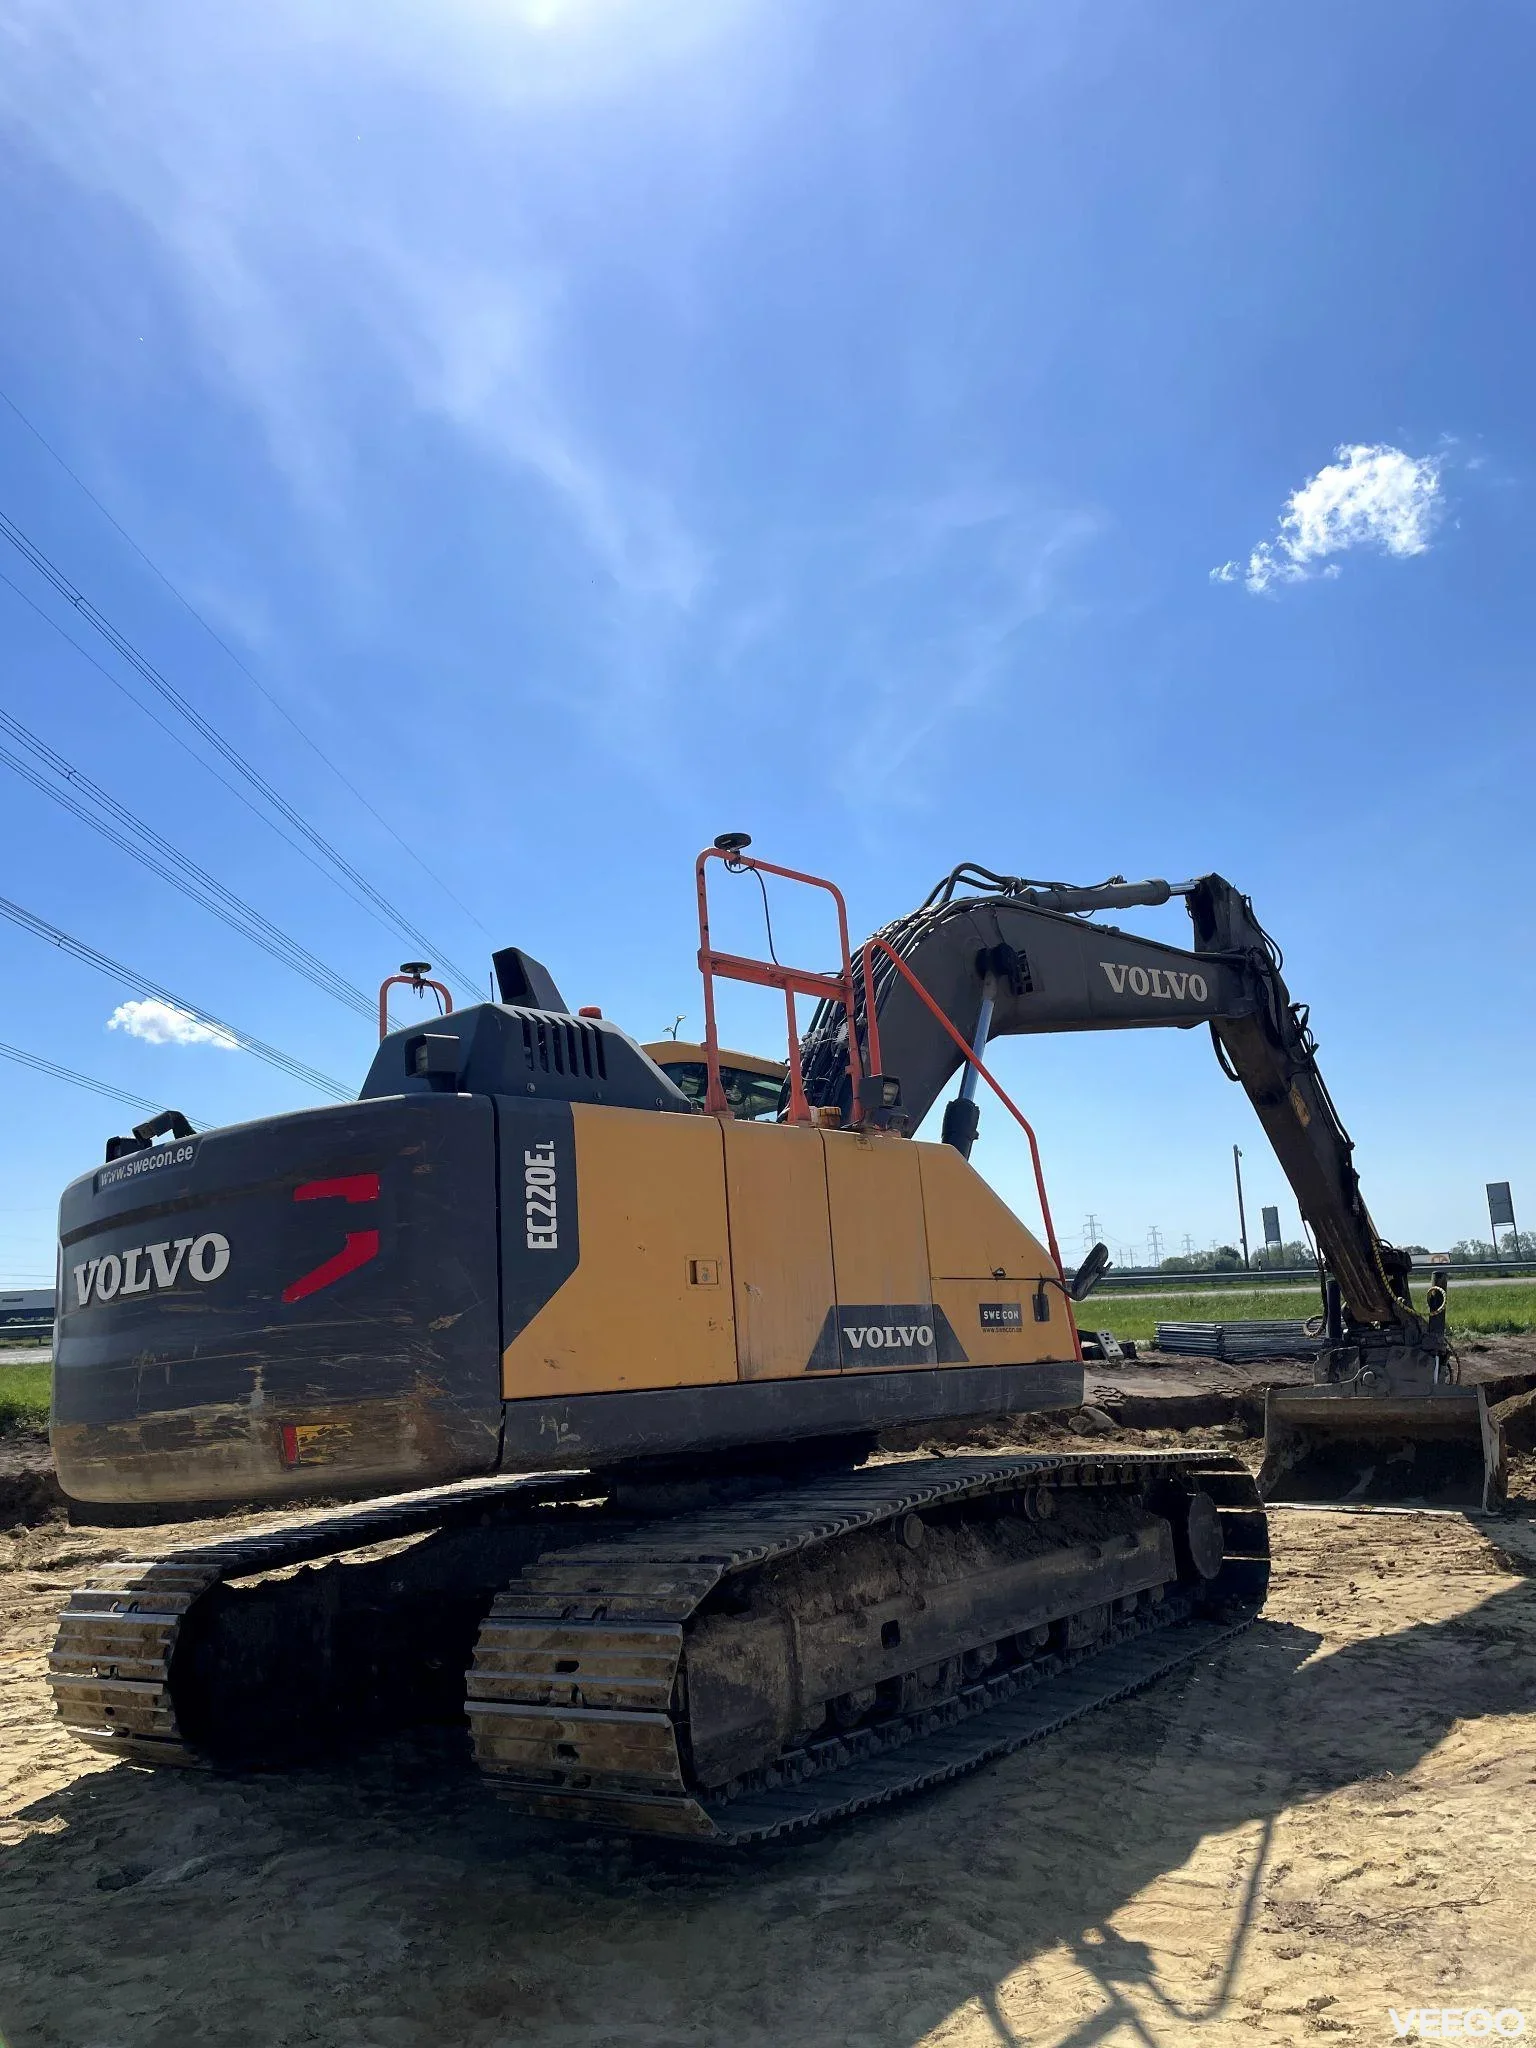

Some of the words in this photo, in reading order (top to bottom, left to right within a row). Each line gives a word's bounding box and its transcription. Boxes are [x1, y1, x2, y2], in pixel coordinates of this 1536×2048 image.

[1100, 962, 1208, 1002] VOLVO
[101, 1145, 194, 1186] www.swecon.ee
[74, 1232, 231, 1305] VOLVO
[843, 1325, 934, 1348] VOLVO
